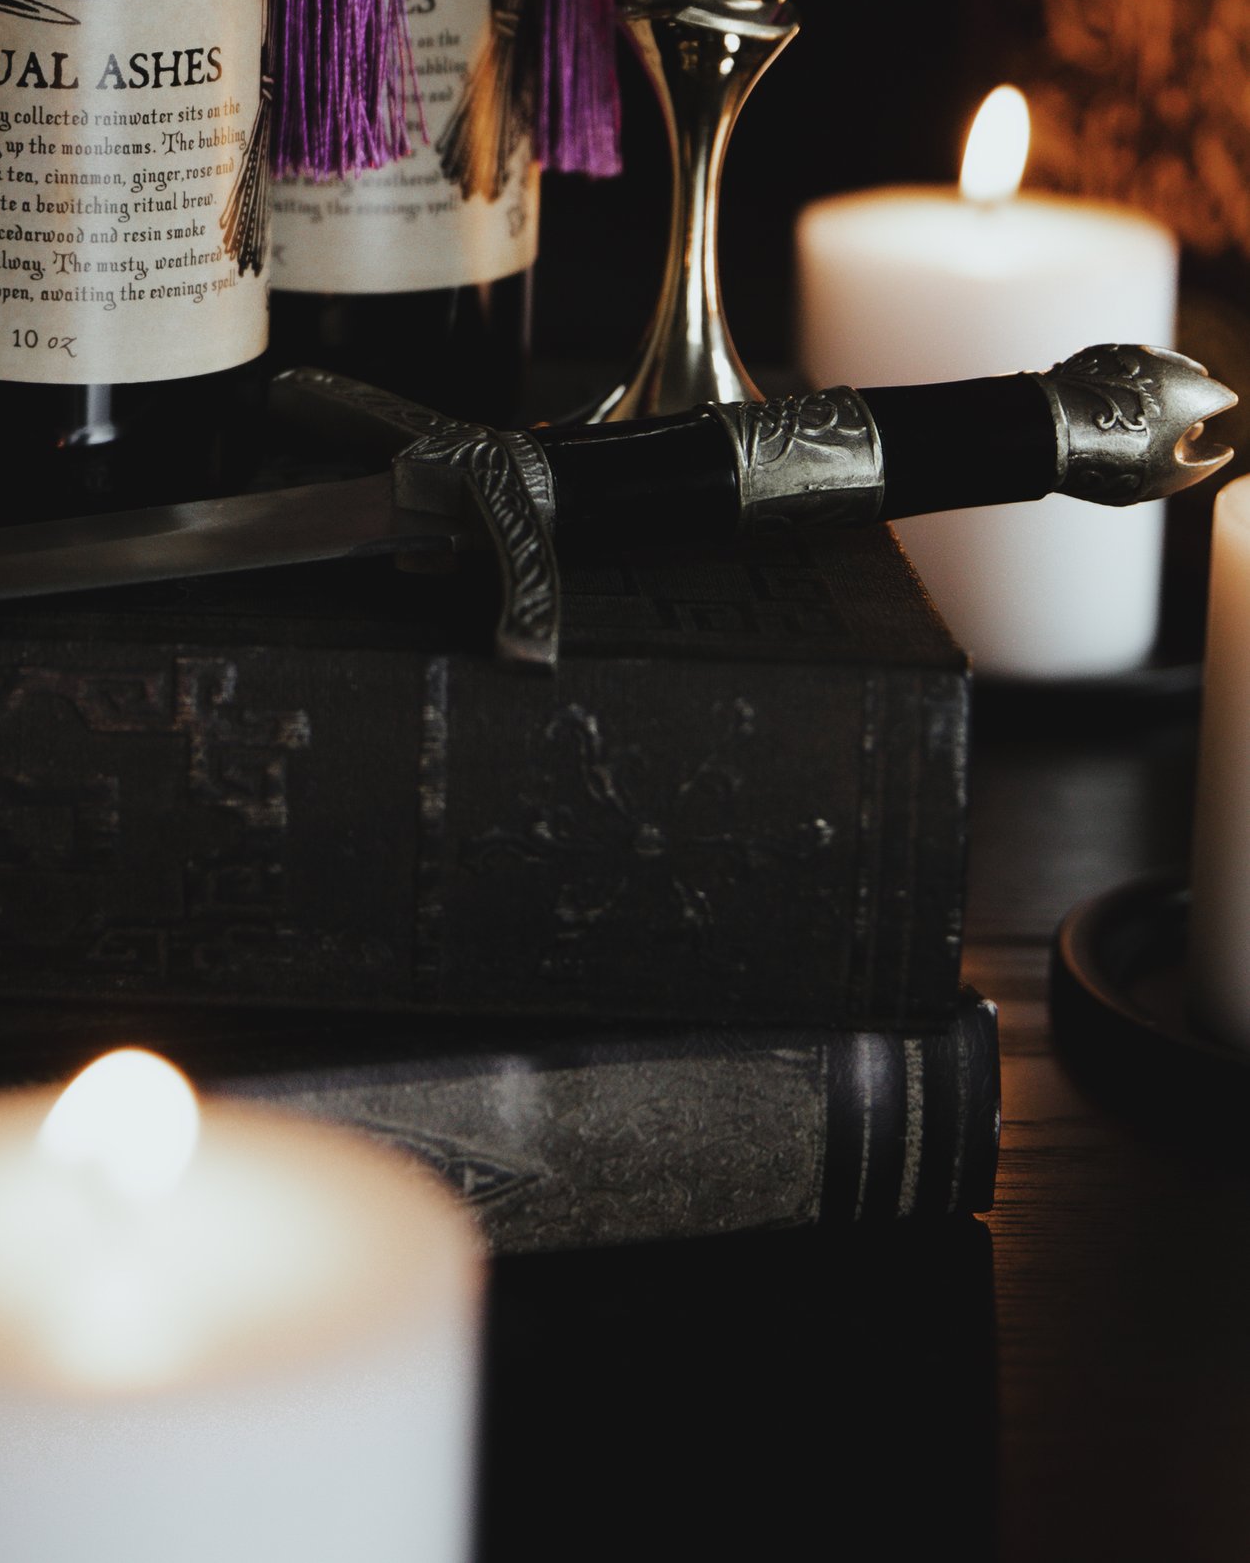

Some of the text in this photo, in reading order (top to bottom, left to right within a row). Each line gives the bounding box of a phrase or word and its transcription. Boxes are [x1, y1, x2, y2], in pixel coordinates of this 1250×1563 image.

[96, 45, 223, 90] ASHES
[14, 105, 89, 126] collected
[94, 108, 174, 126] rainwater
[178, 104, 203, 123] sits
[207, 105, 221, 119] on
[222, 96, 241, 116] the
[6, 141, 24, 159] up
[28, 135, 56, 155] the
[61, 136, 157, 156] moonbeams.
[161, 130, 195, 156] The
[198, 127, 248, 151] bubbling
[7, 165, 39, 186] tea,
[45, 169, 127, 187] cinnamon,
[186, 165, 213, 180] rose
[215, 157, 235, 175] and
[21, 199, 31, 213] a
[37, 193, 131, 224] bewitching
[134, 192, 178, 214] ritual
[182, 190, 218, 210] brew.
[90, 226, 118, 244] and
[123, 223, 162, 243] resin
[166, 218, 207, 241] smoke
[52, 250, 92, 275] The
[96, 255, 150, 281] musty,
[155, 245, 223, 270] weathered
[40, 287, 117, 312] awaiting
[120, 281, 146, 302] the
[150, 280, 209, 304] evenings
[11, 329, 78, 358] 10 oz
